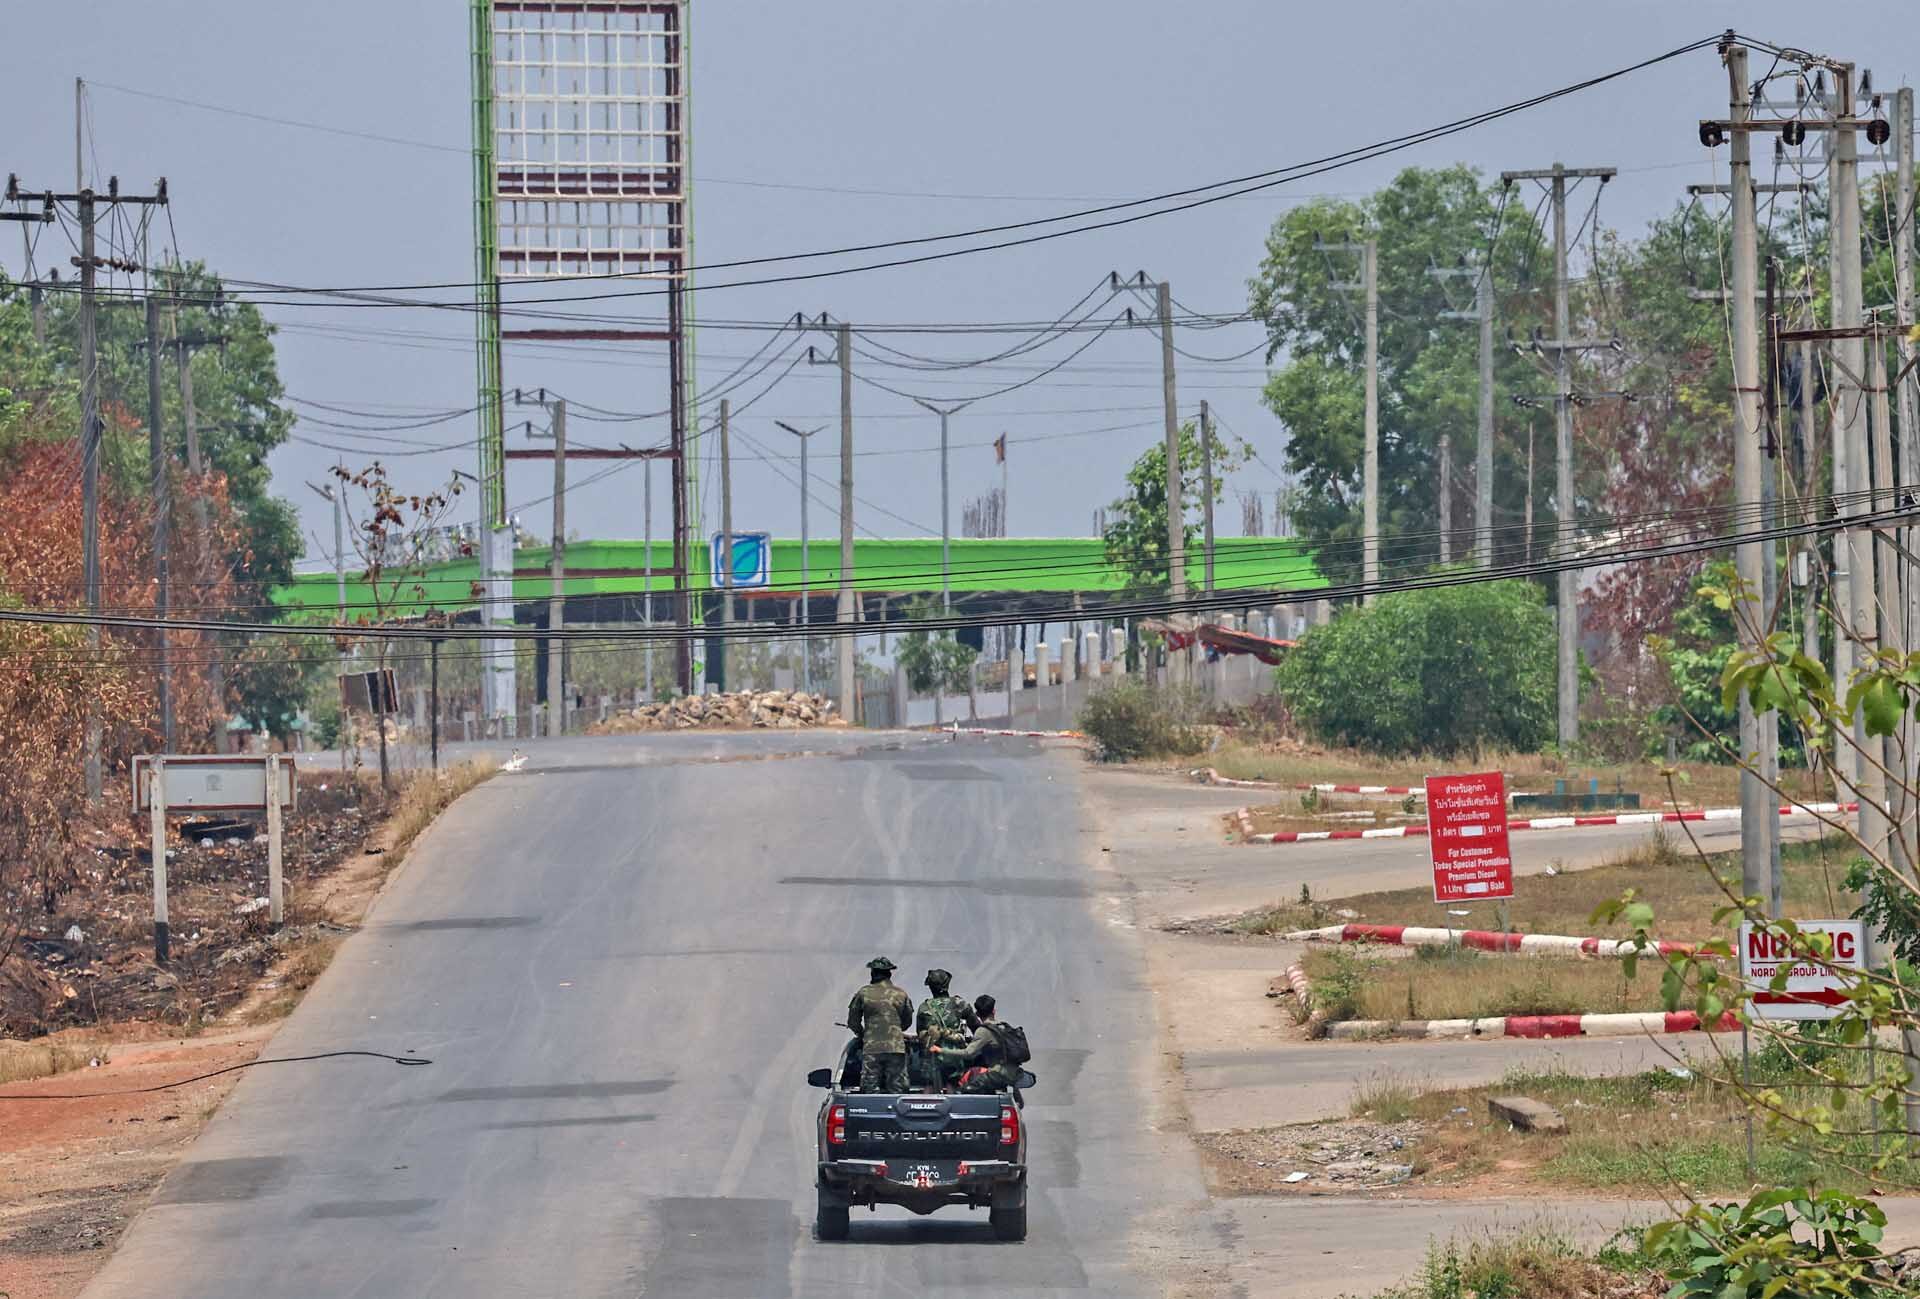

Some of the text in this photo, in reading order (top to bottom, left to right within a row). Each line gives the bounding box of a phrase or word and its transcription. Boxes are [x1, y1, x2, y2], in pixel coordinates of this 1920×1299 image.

[1448, 847, 1493, 858] For Customers
[1434, 857, 1509, 871] Today Special Promotion
[1448, 869, 1497, 881] Premium Diesel
[1448, 884, 1463, 894] Litre
[1751, 967, 1783, 977] NORD
[858, 1131, 988, 1141] REVOLUTION
